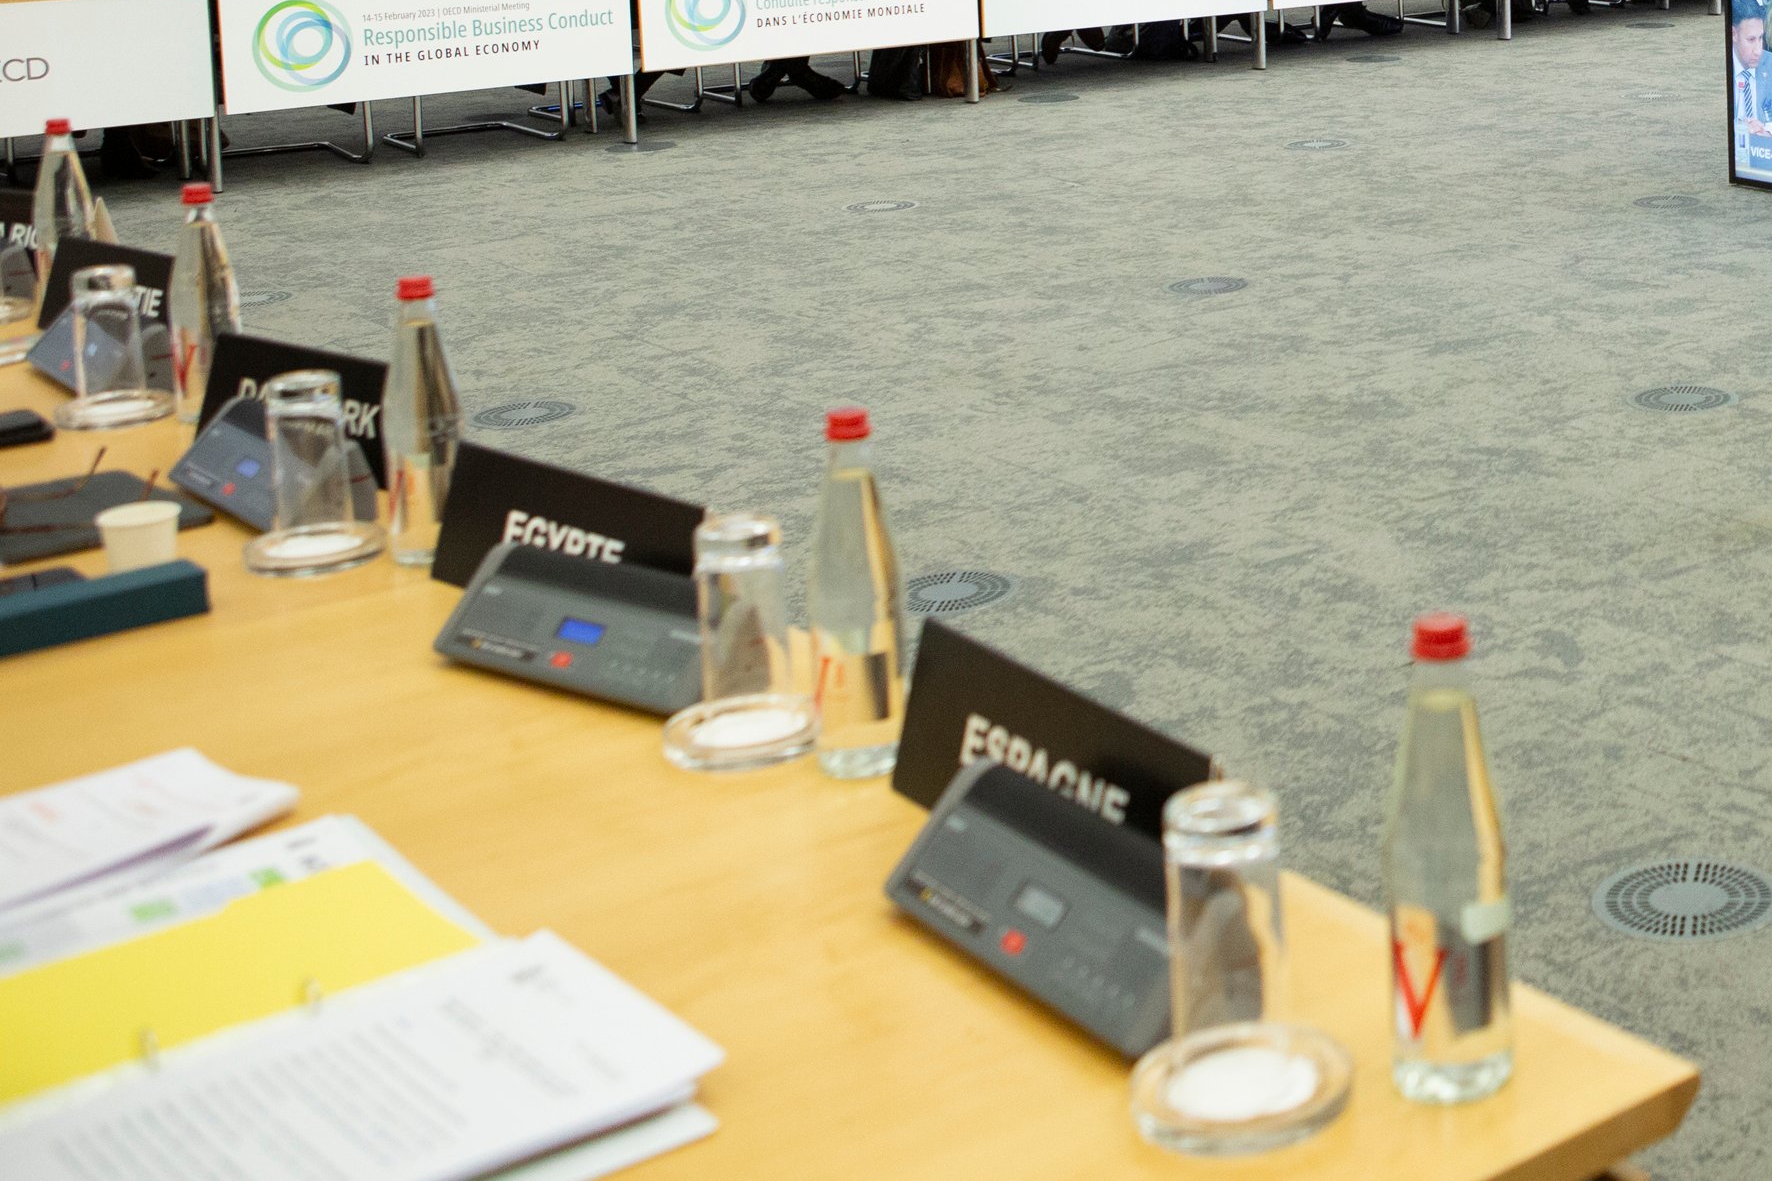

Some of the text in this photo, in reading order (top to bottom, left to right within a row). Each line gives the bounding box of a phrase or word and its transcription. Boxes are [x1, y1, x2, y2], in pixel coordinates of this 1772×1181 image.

[362, 1, 530, 22] 14-15 February 2023 OECD Ministerial Meeting
[757, 16, 787, 28] DANS
[868, 3, 925, 18] MONDIALE
[364, 8, 613, 49] Responsible Business Conduct
[364, 40, 540, 66] IN THE GLOBAL ECONOMY
[0, 57, 50, 82] CD
